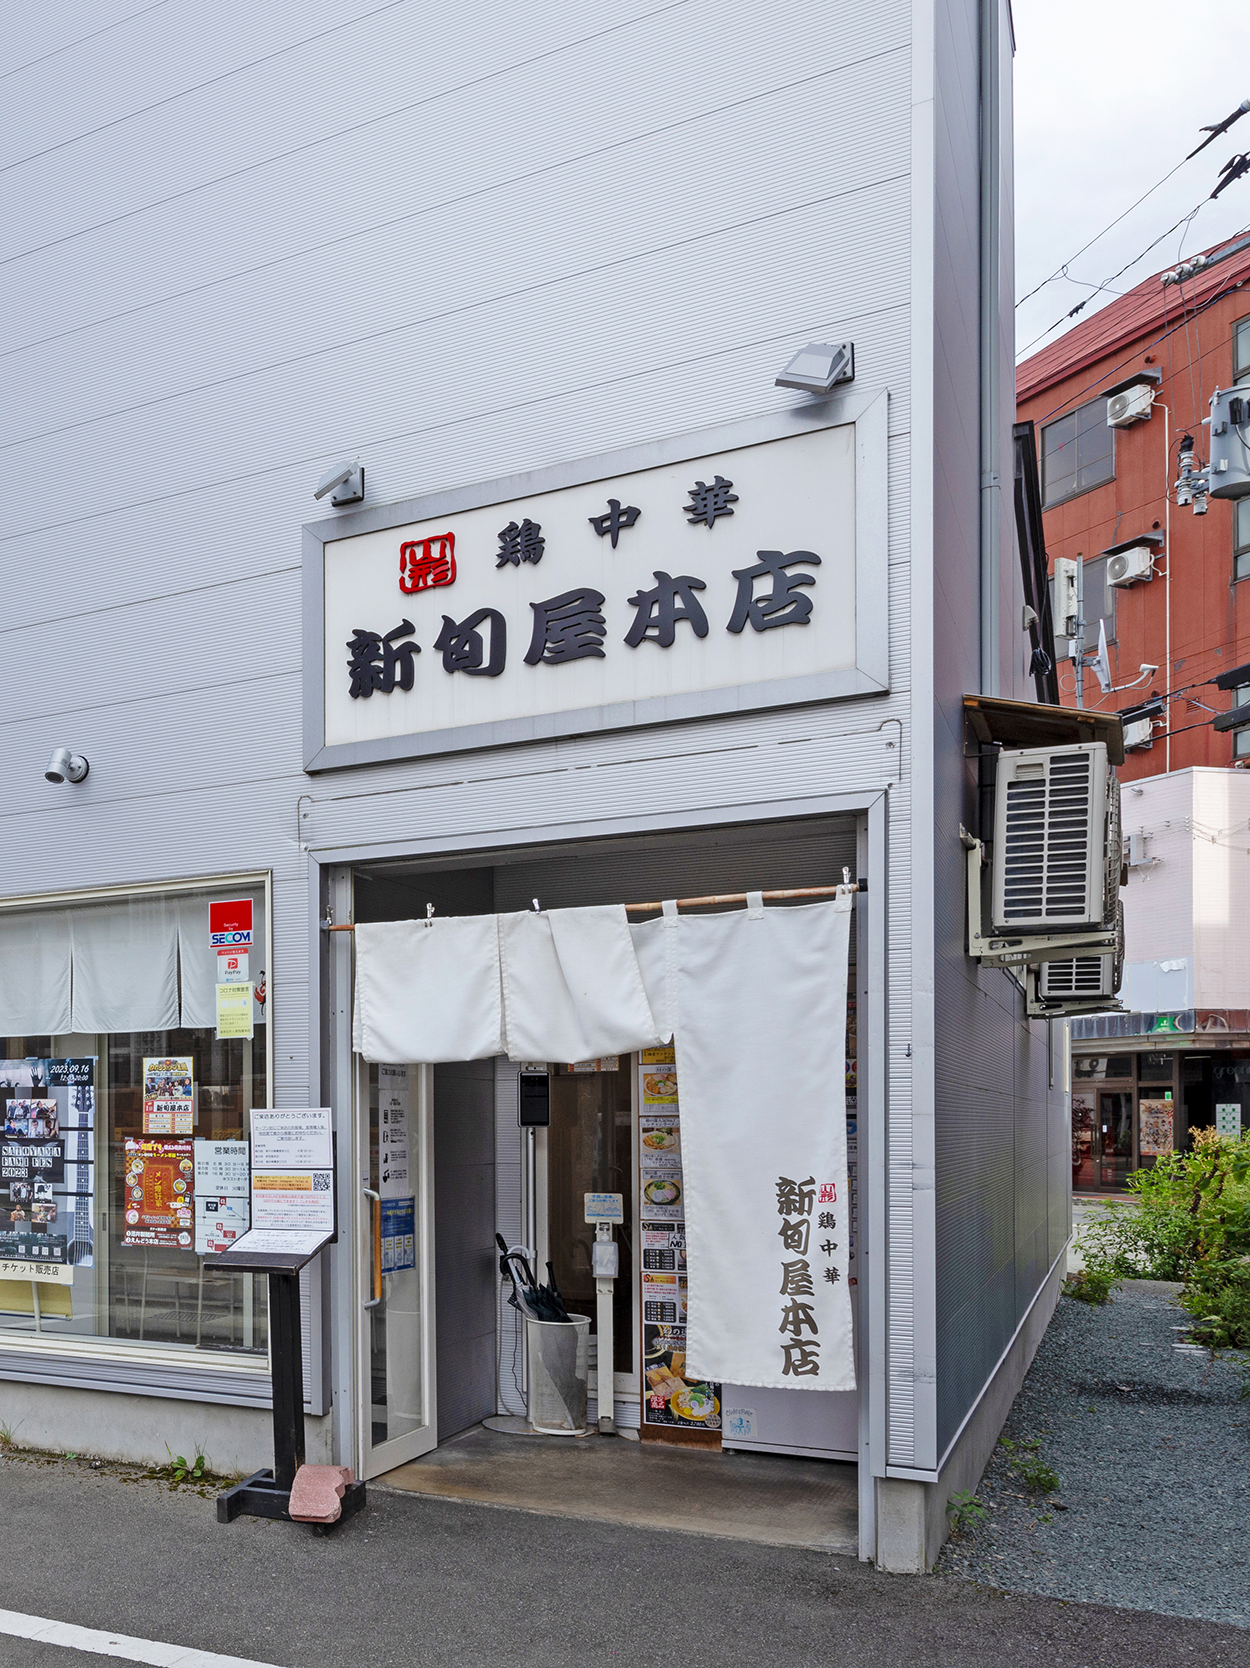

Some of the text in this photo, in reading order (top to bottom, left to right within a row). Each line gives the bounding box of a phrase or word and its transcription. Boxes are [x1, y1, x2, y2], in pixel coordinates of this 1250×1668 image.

[495, 475, 739, 569] 鶏中華
[347, 549, 821, 699] 新旬屋本店
[212, 931, 251, 945] SECOM
[50, 1064, 90, 1074] 2023.09.16
[1, 1146, 61, 1157] SATOYAMA
[214, 1146, 247, 1156] 営業時間
[1, 1167, 28, 1178] 2023
[817, 1211, 841, 1285] 鶏中華
[2, 1262, 60, 1276] チケット販売店
[775, 1175, 821, 1377] 新旬屋本店
